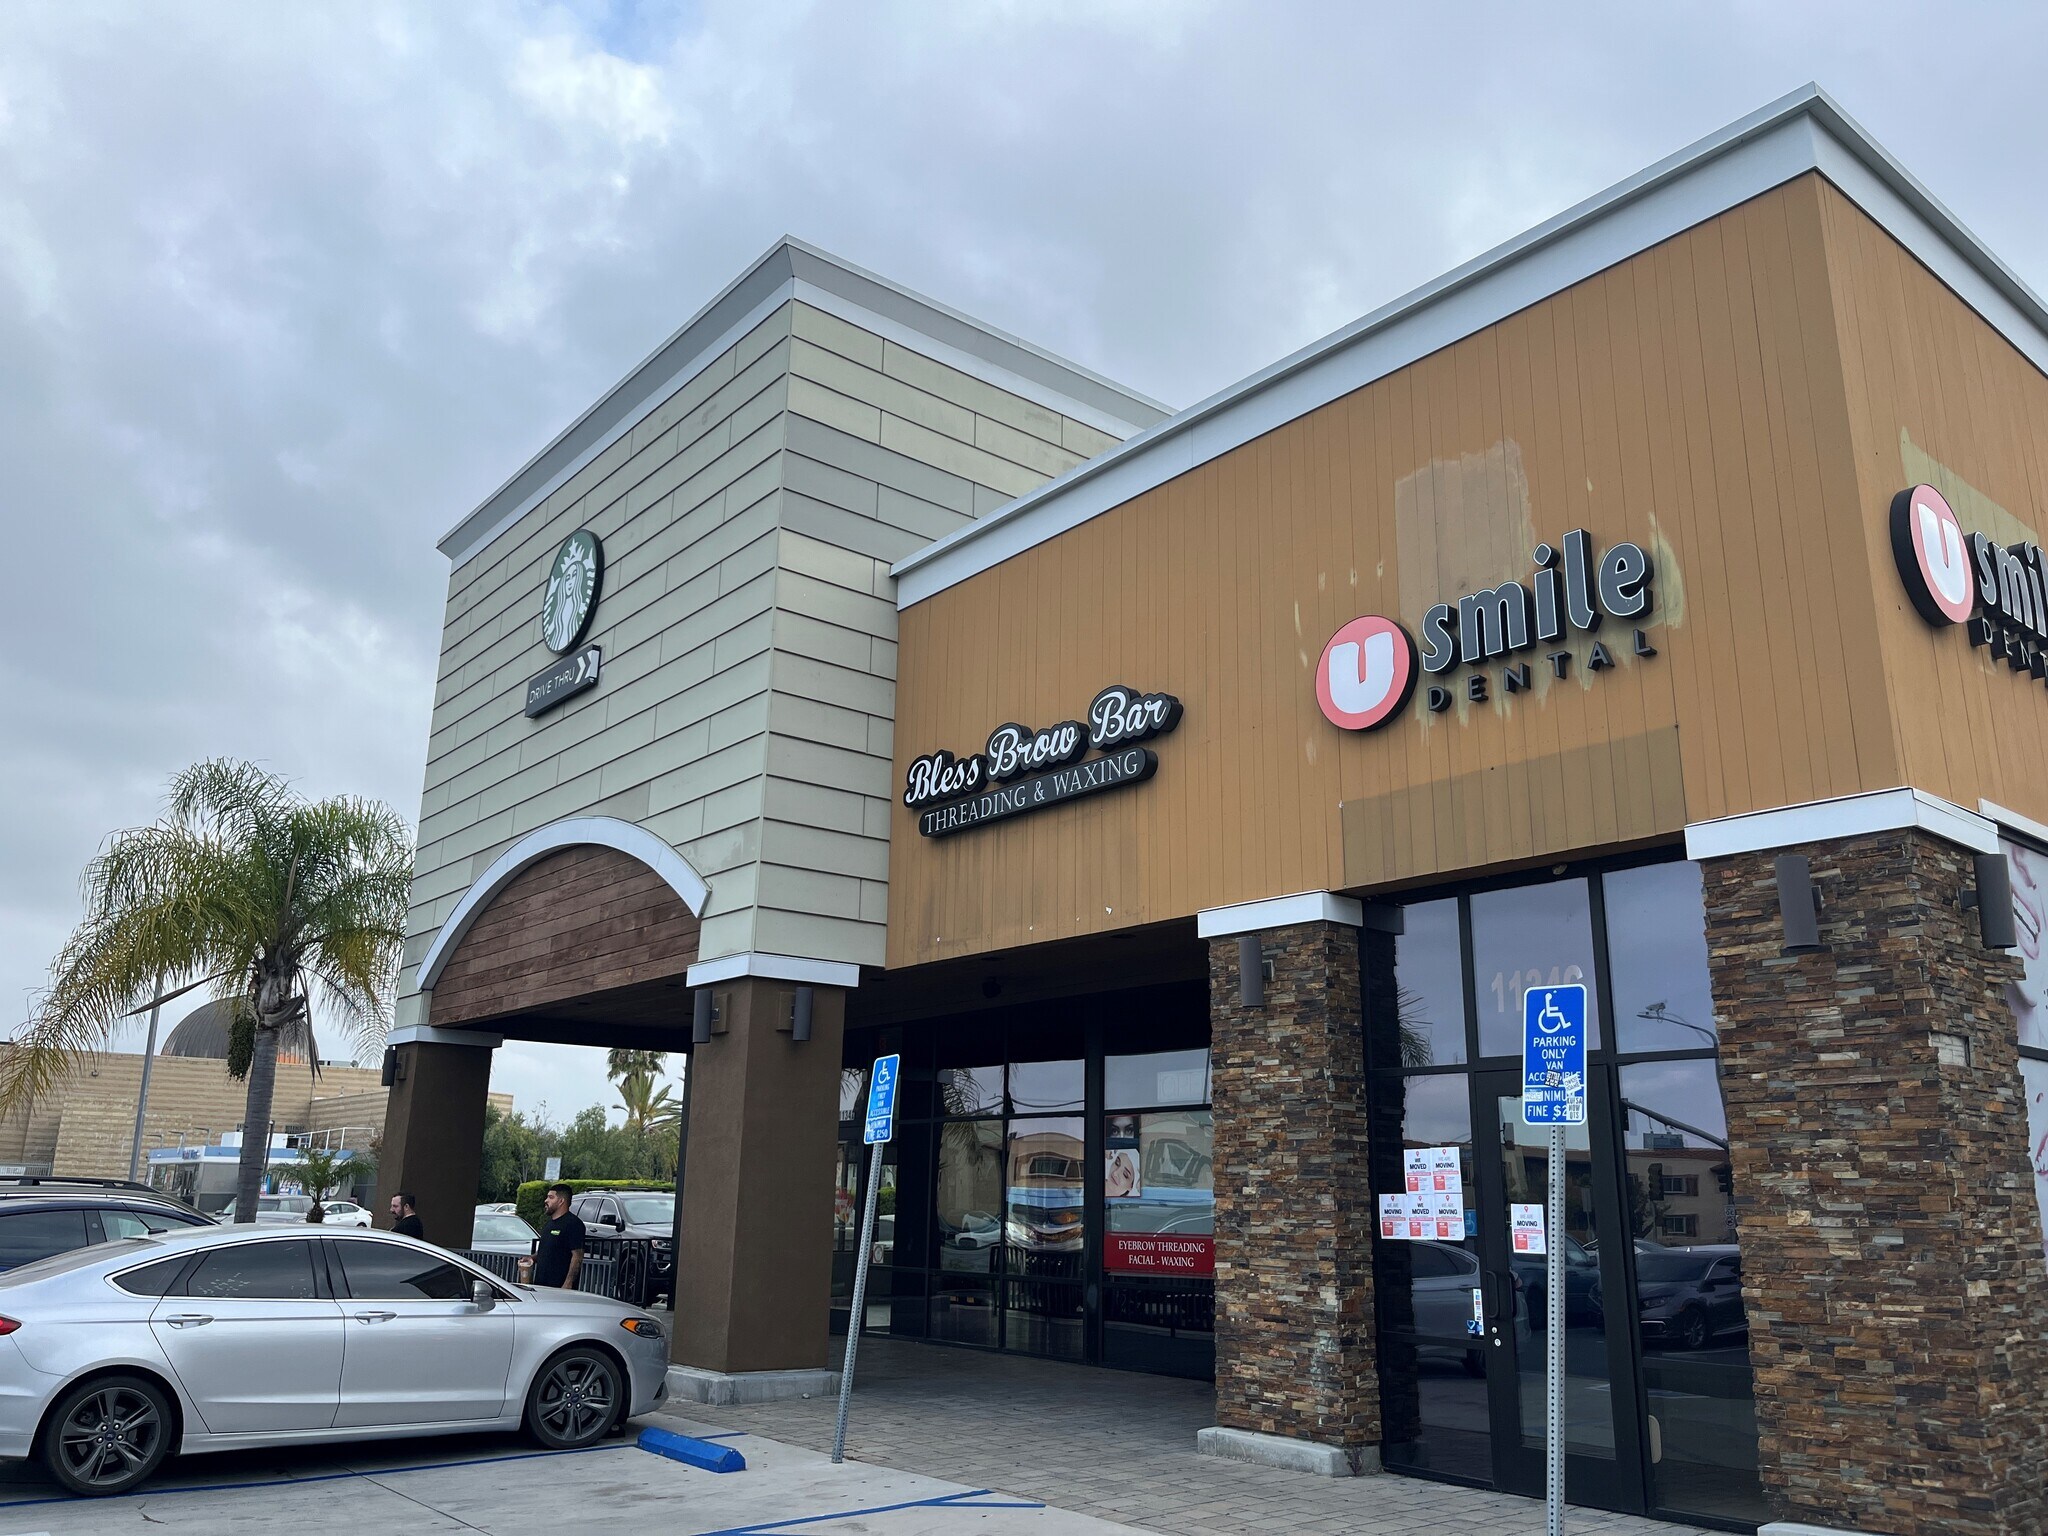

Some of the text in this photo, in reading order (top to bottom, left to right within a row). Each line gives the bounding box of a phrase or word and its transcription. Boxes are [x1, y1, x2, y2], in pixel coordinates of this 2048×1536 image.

[1422, 528, 1648, 673] smile
[1428, 629, 1657, 712] DENTAL
[529, 667, 575, 703] DRIVE THRU
[905, 690, 1167, 804] Bless Brow Bar
[925, 751, 1138, 833] THREADING & WAXING
[1533, 1035, 1576, 1047] PARKING
[1541, 1049, 1567, 1060] ONLY
[1546, 1061, 1564, 1070] VAN
[1527, 1104, 1567, 1117] FINE $2
[1118, 1240, 1205, 1253] EYEBROW THREADING
[1128, 1254, 1155, 1265] FACIAL
[1161, 1256, 1194, 1267] WAXING
